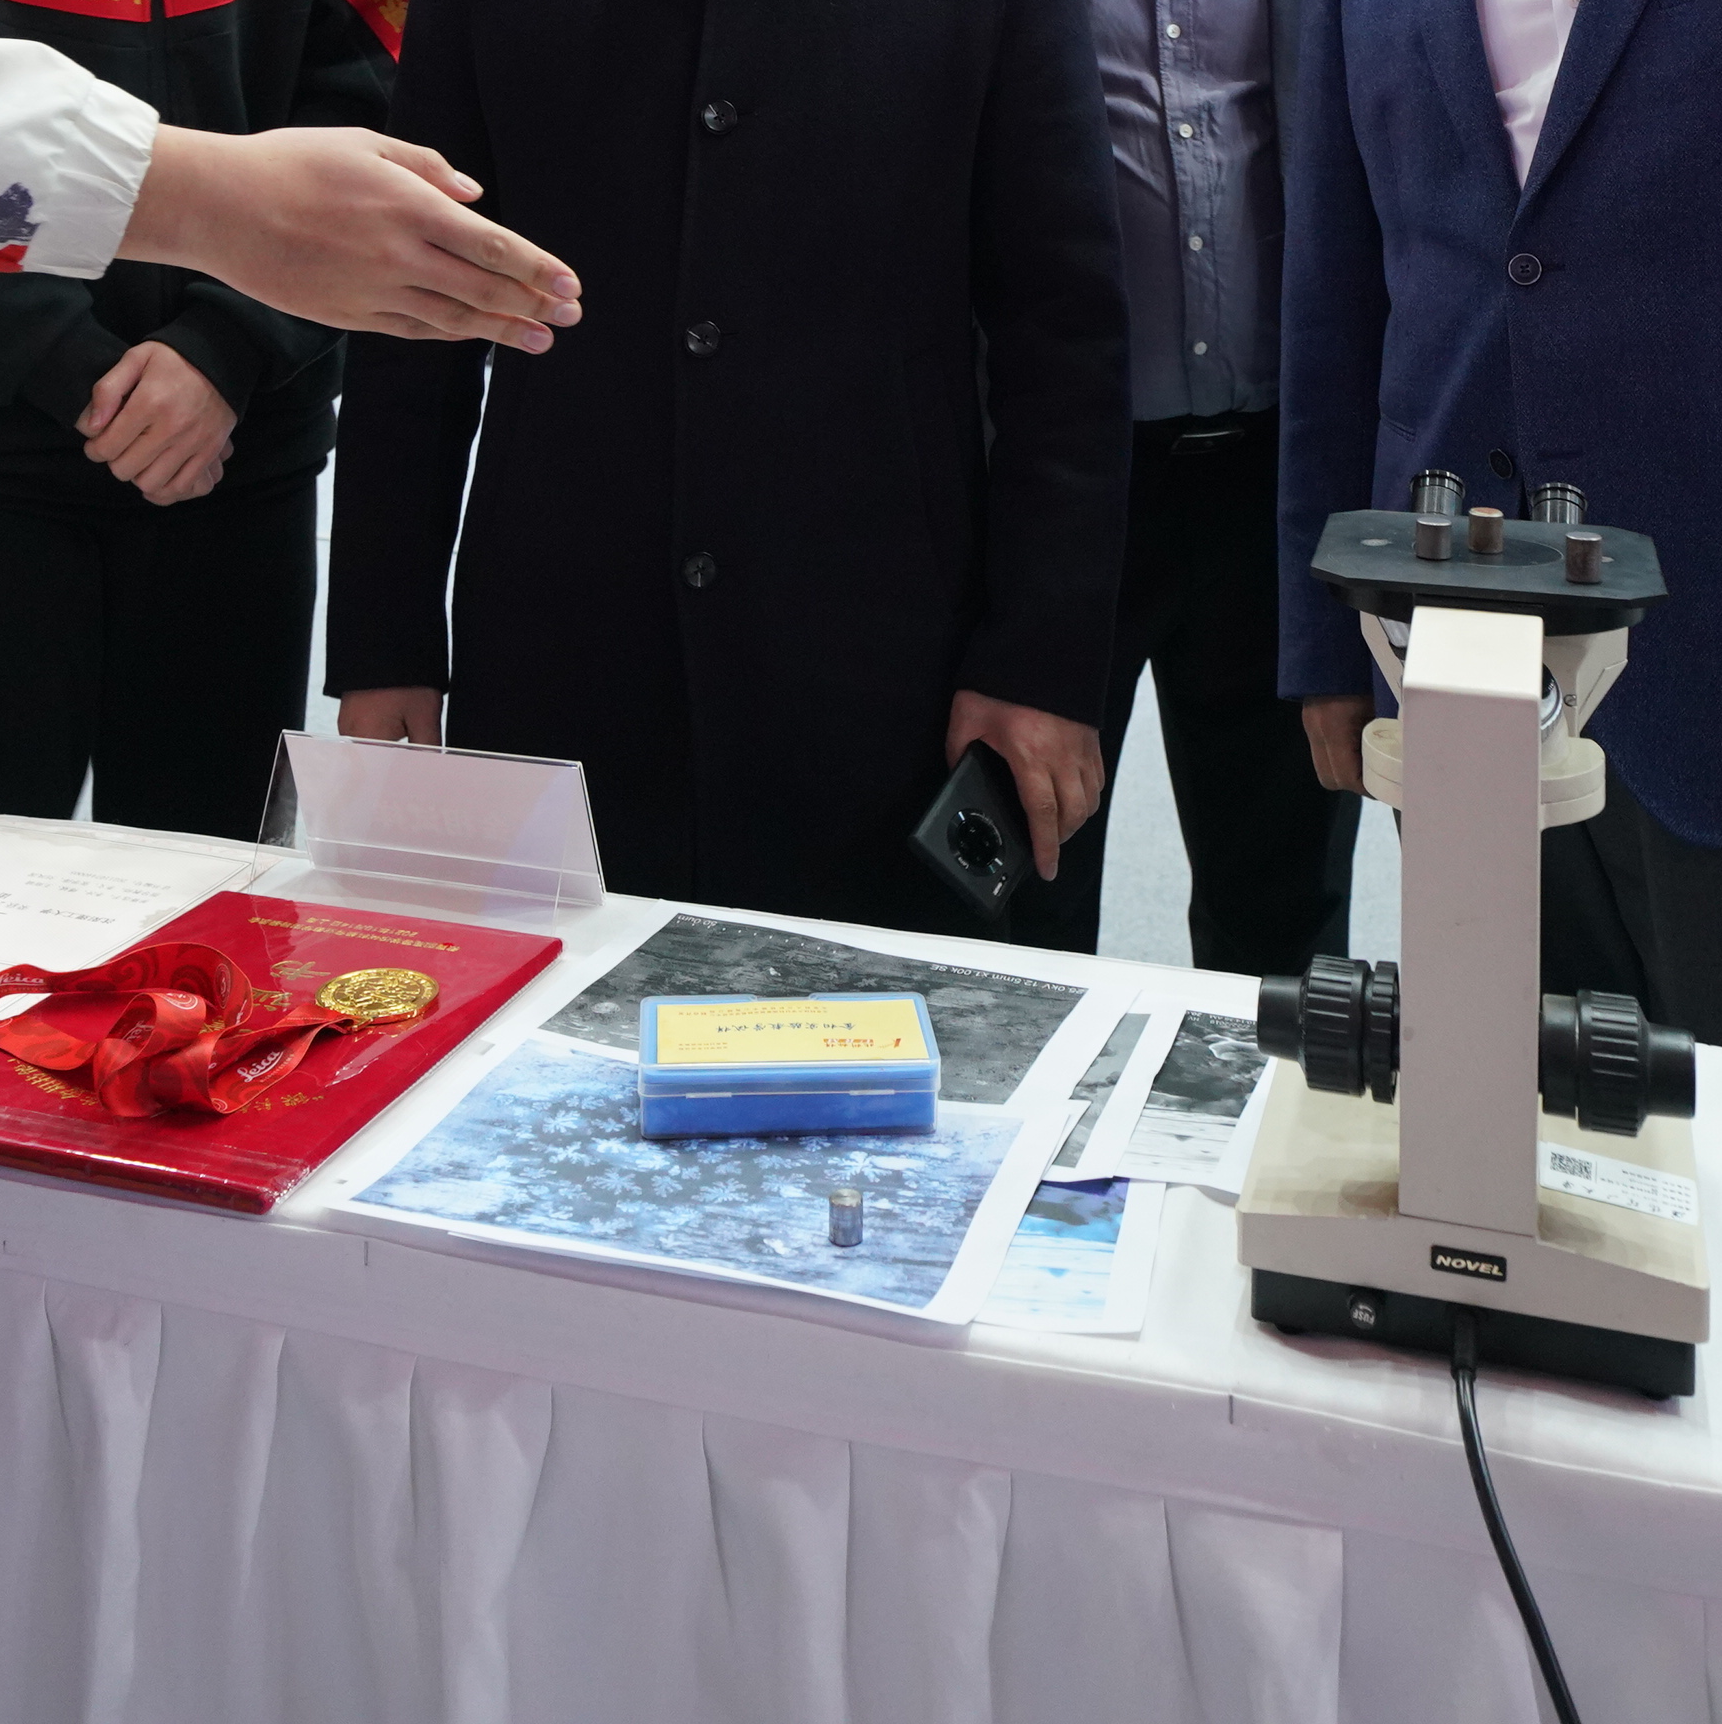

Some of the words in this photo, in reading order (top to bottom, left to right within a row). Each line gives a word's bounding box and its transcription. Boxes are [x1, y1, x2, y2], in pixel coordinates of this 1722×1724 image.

[237, 1050, 284, 1083] Leica
[1435, 1254, 1504, 1277] NOVEL
[1351, 1308, 1376, 1326] FUSE
